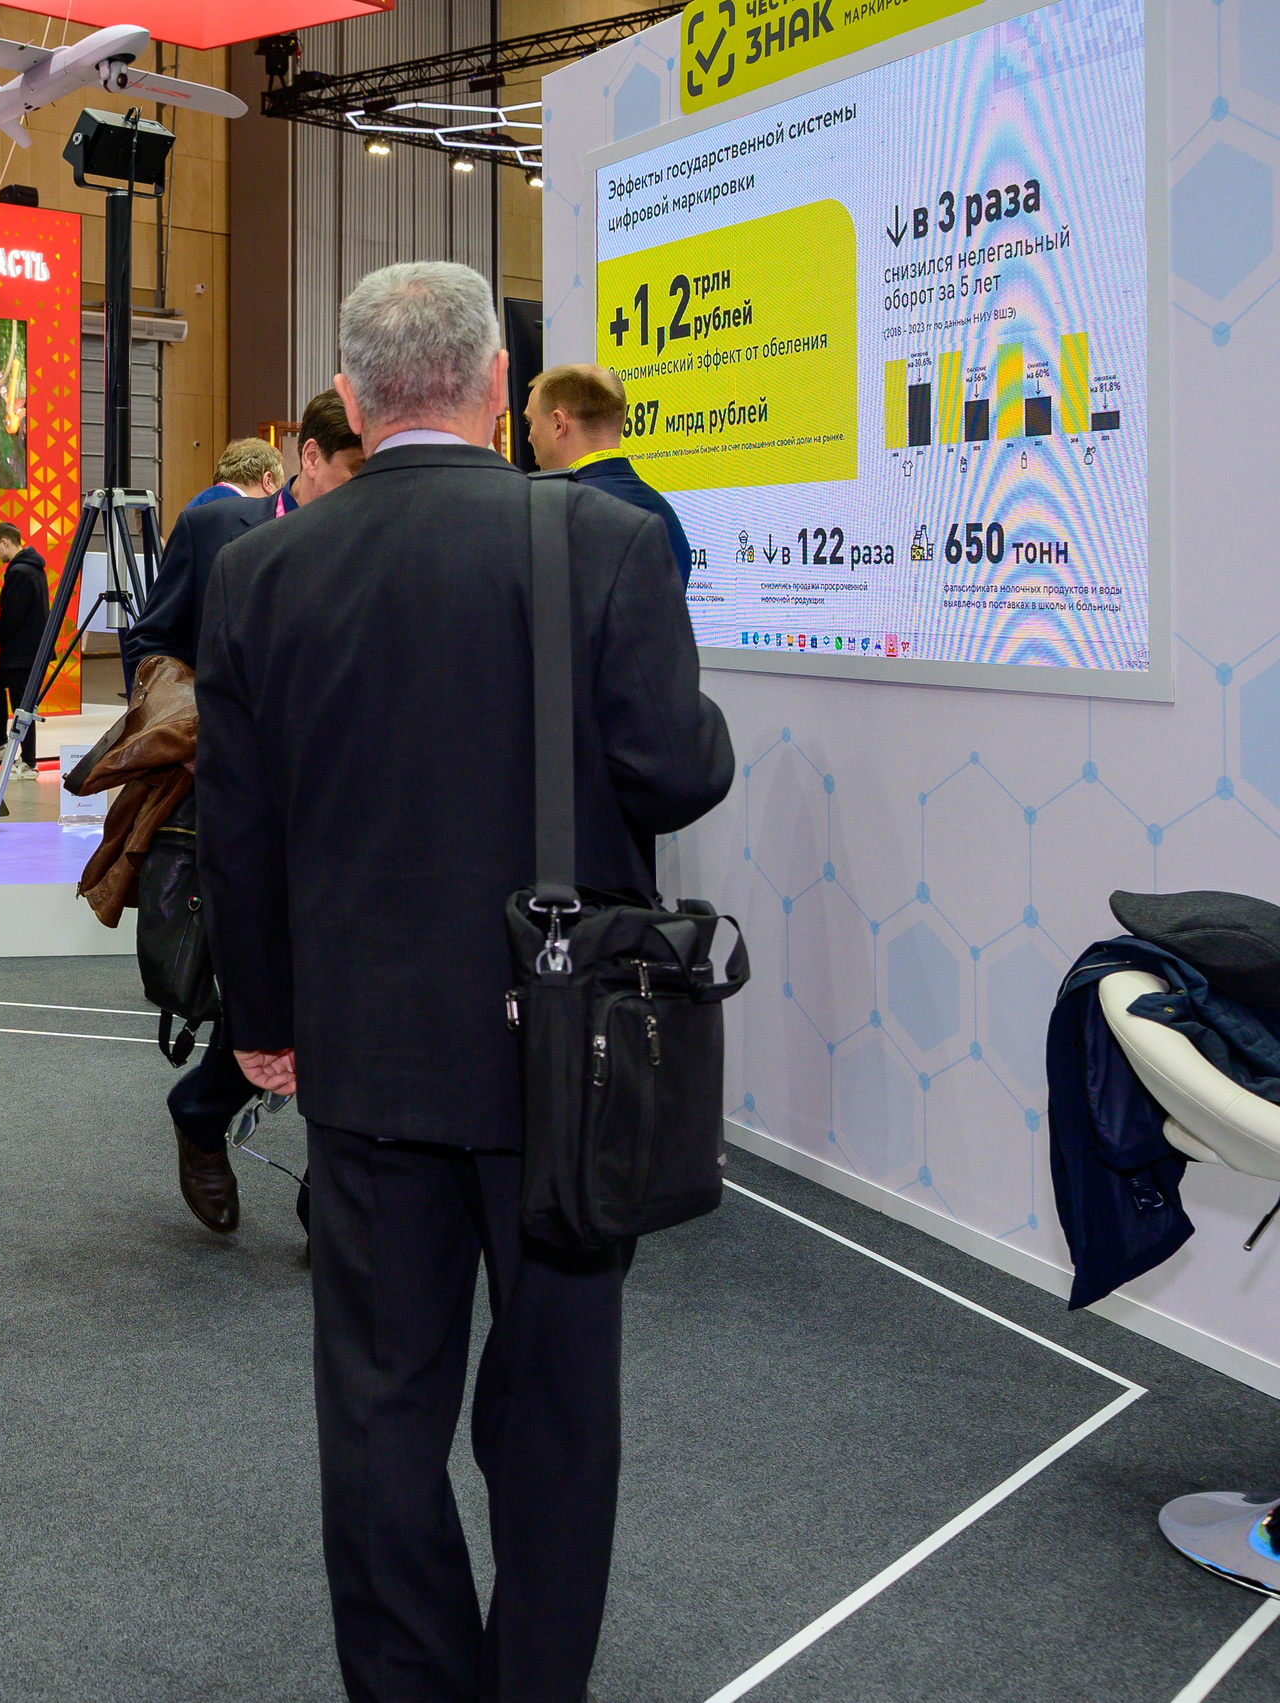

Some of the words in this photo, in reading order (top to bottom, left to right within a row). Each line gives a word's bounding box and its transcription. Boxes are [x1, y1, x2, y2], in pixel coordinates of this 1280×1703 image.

[746, 0, 796, 18] ЧЕС
[844, 0, 908, 26] МАРКИР
[745, 0, 834, 65] ЗНАК
[608, 167, 663, 200] Эффекты
[666, 122, 785, 182] государственной
[788, 103, 858, 141] системы
[608, 195, 669, 232] цифровой
[672, 174, 755, 214] маркировки
[913, 207, 929, 239] в
[938, 190, 955, 233] 3
[966, 179, 1041, 238] раза
[884, 254, 953, 284] снизился
[958, 225, 1070, 270] нелегальный
[884, 286, 935, 312] оборот
[938, 283, 955, 302] за
[960, 275, 969, 297] 5
[973, 273, 1001, 296] лет
[609, 274, 691, 358] +1,2
[693, 269, 731, 299] трлн
[693, 299, 753, 340] рублей
[697, 348, 742, 373] эффект
[746, 345, 759, 361] от
[762, 333, 828, 358] обеления
[665, 411, 705, 437] млрд
[709, 396, 768, 434] рублей
[782, 547, 791, 565] в
[797, 527, 844, 565] 122
[850, 544, 894, 571] раза
[944, 522, 1005, 564] 650
[1012, 541, 1069, 564] тонн
[1042, 585, 1089, 596] продуктов
[1099, 586, 1123, 596] воды
[1075, 600, 1121, 613] больницы
